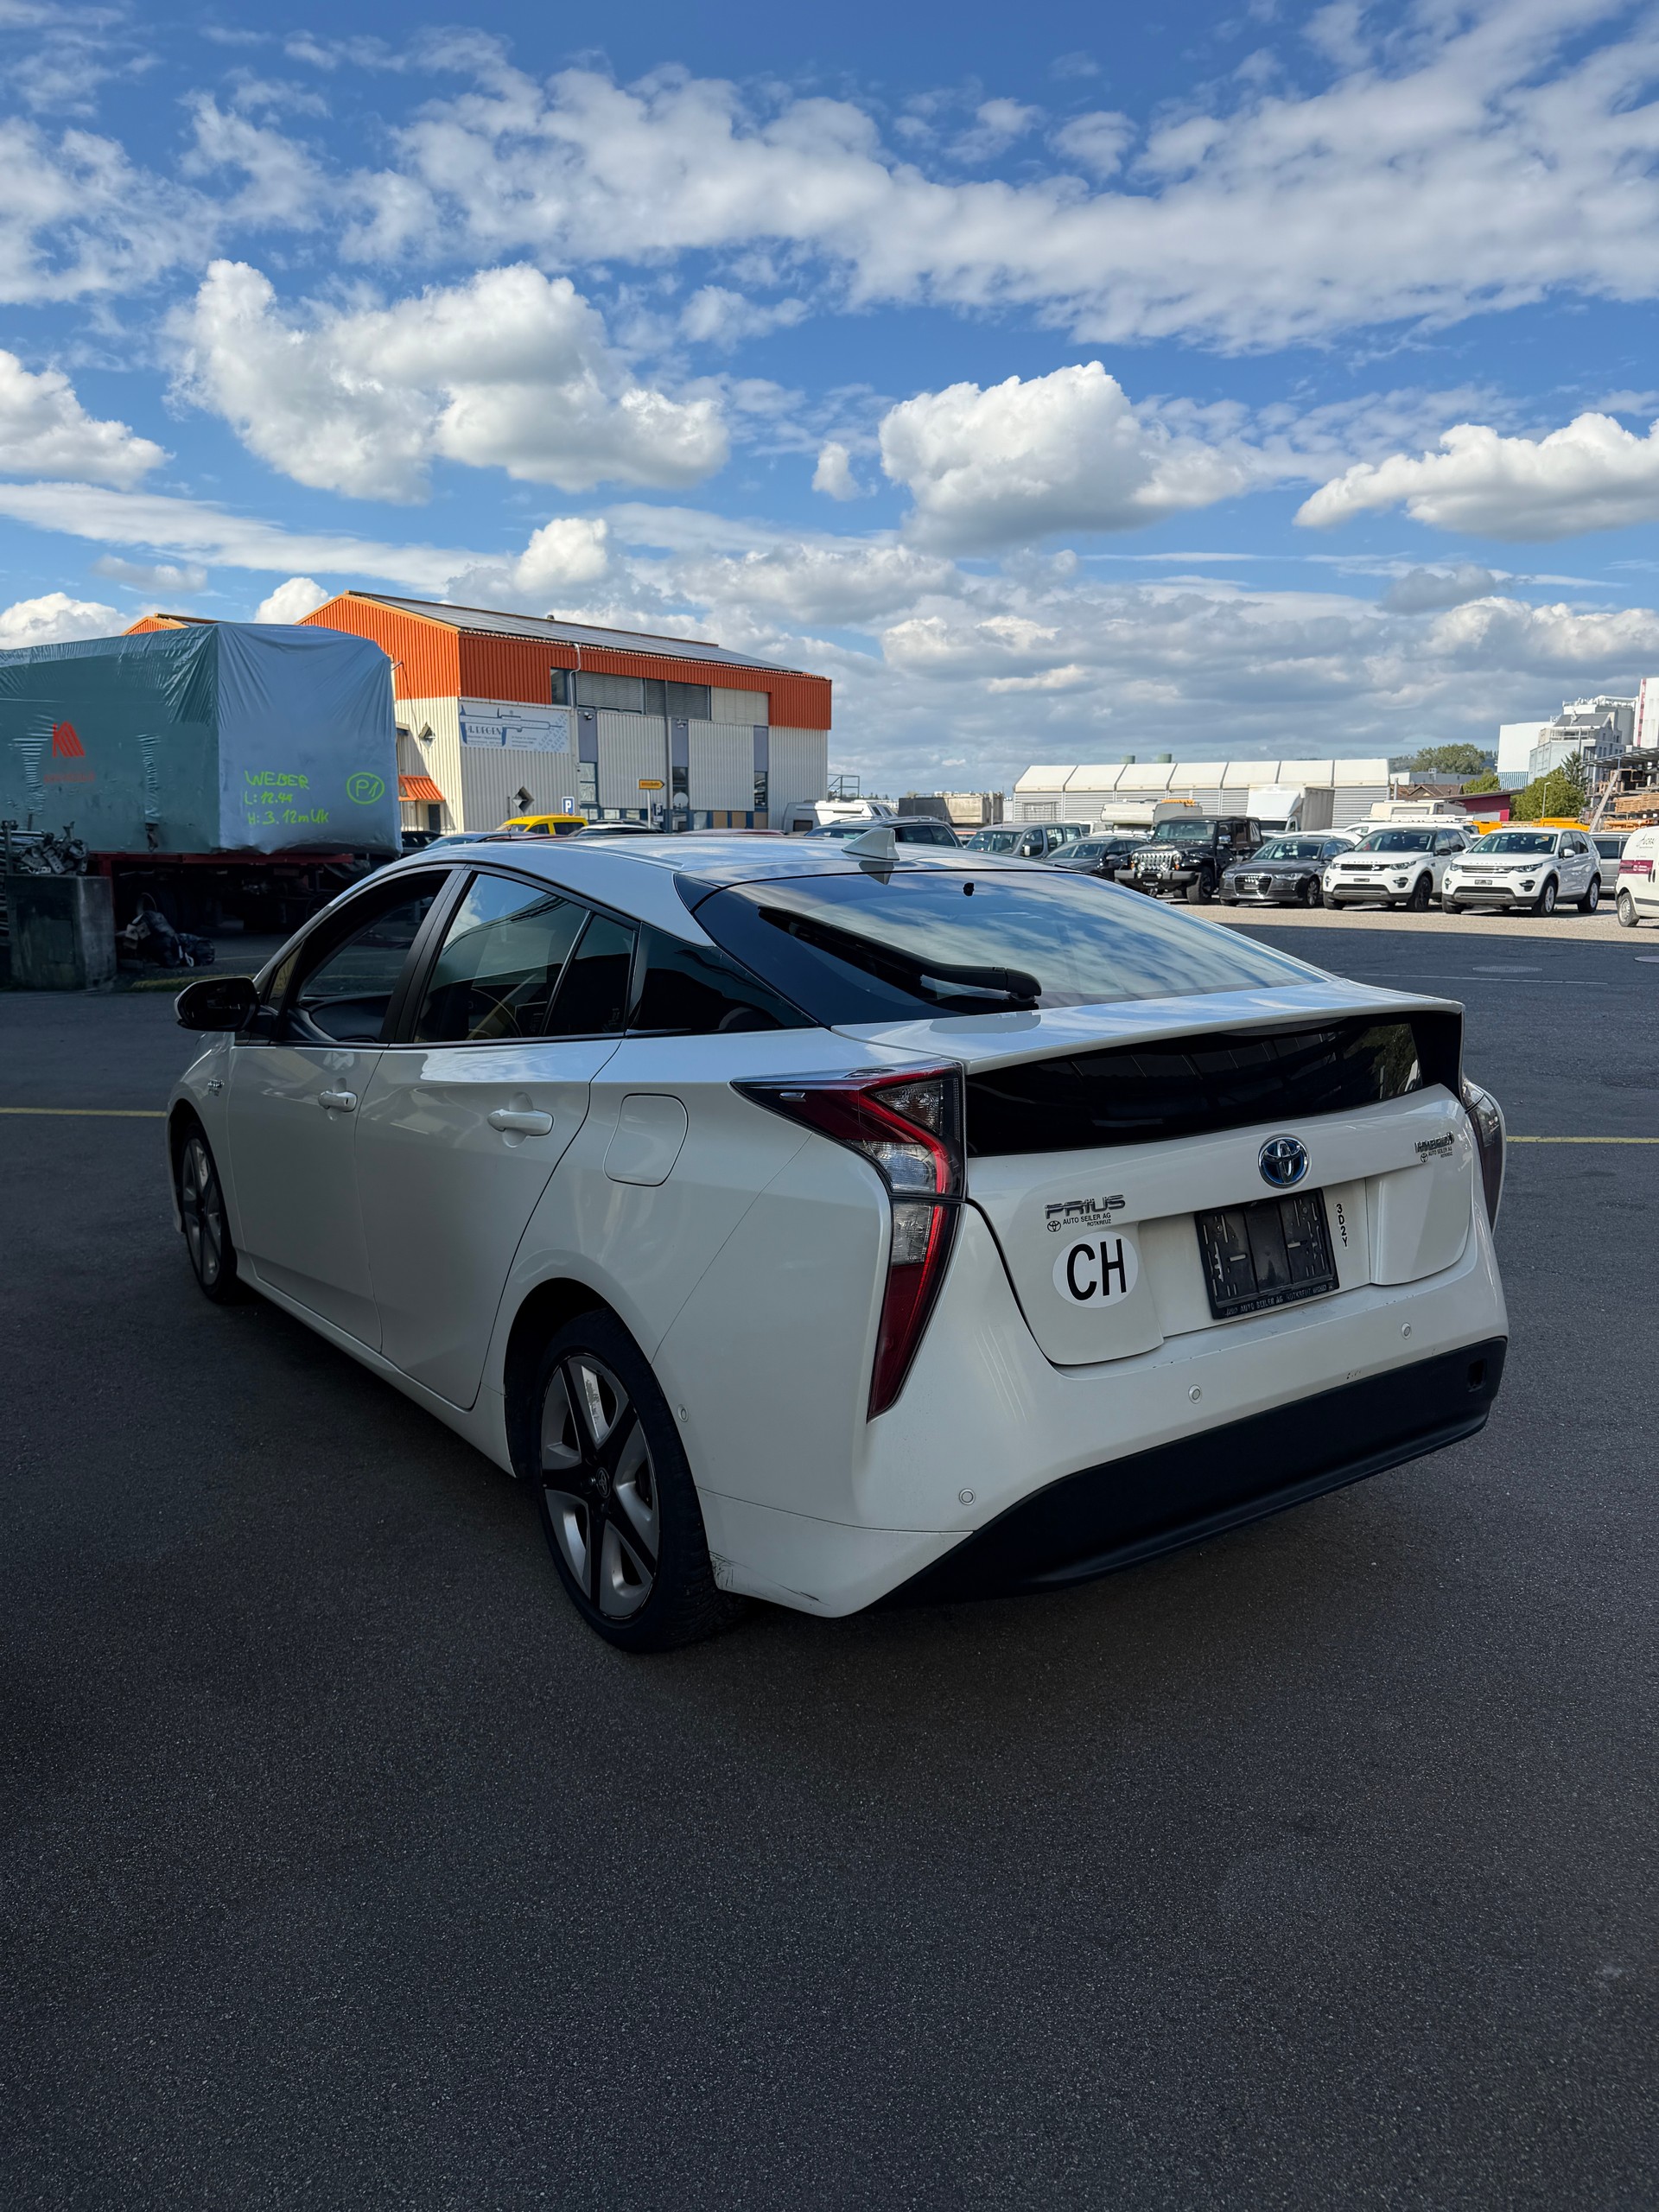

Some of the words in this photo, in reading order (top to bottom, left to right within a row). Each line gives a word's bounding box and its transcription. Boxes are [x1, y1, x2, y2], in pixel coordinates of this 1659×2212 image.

[245, 770, 310, 790] WEBER
[355, 779, 379, 798] P1
[565, 799, 572, 813] P
[1045, 1194, 1126, 1219] PRIUS
[1063, 1217, 1079, 1225] AUTO
[1080, 1213, 1102, 1223] SEILER
[1087, 1218, 1112, 1227] ROTKREUZ
[1066, 1238, 1127, 1301] CH
[1240, 1304, 1255, 1313] AUTO
[1256, 1297, 1275, 1309] SEILER
[1275, 1295, 1284, 1305] AG
